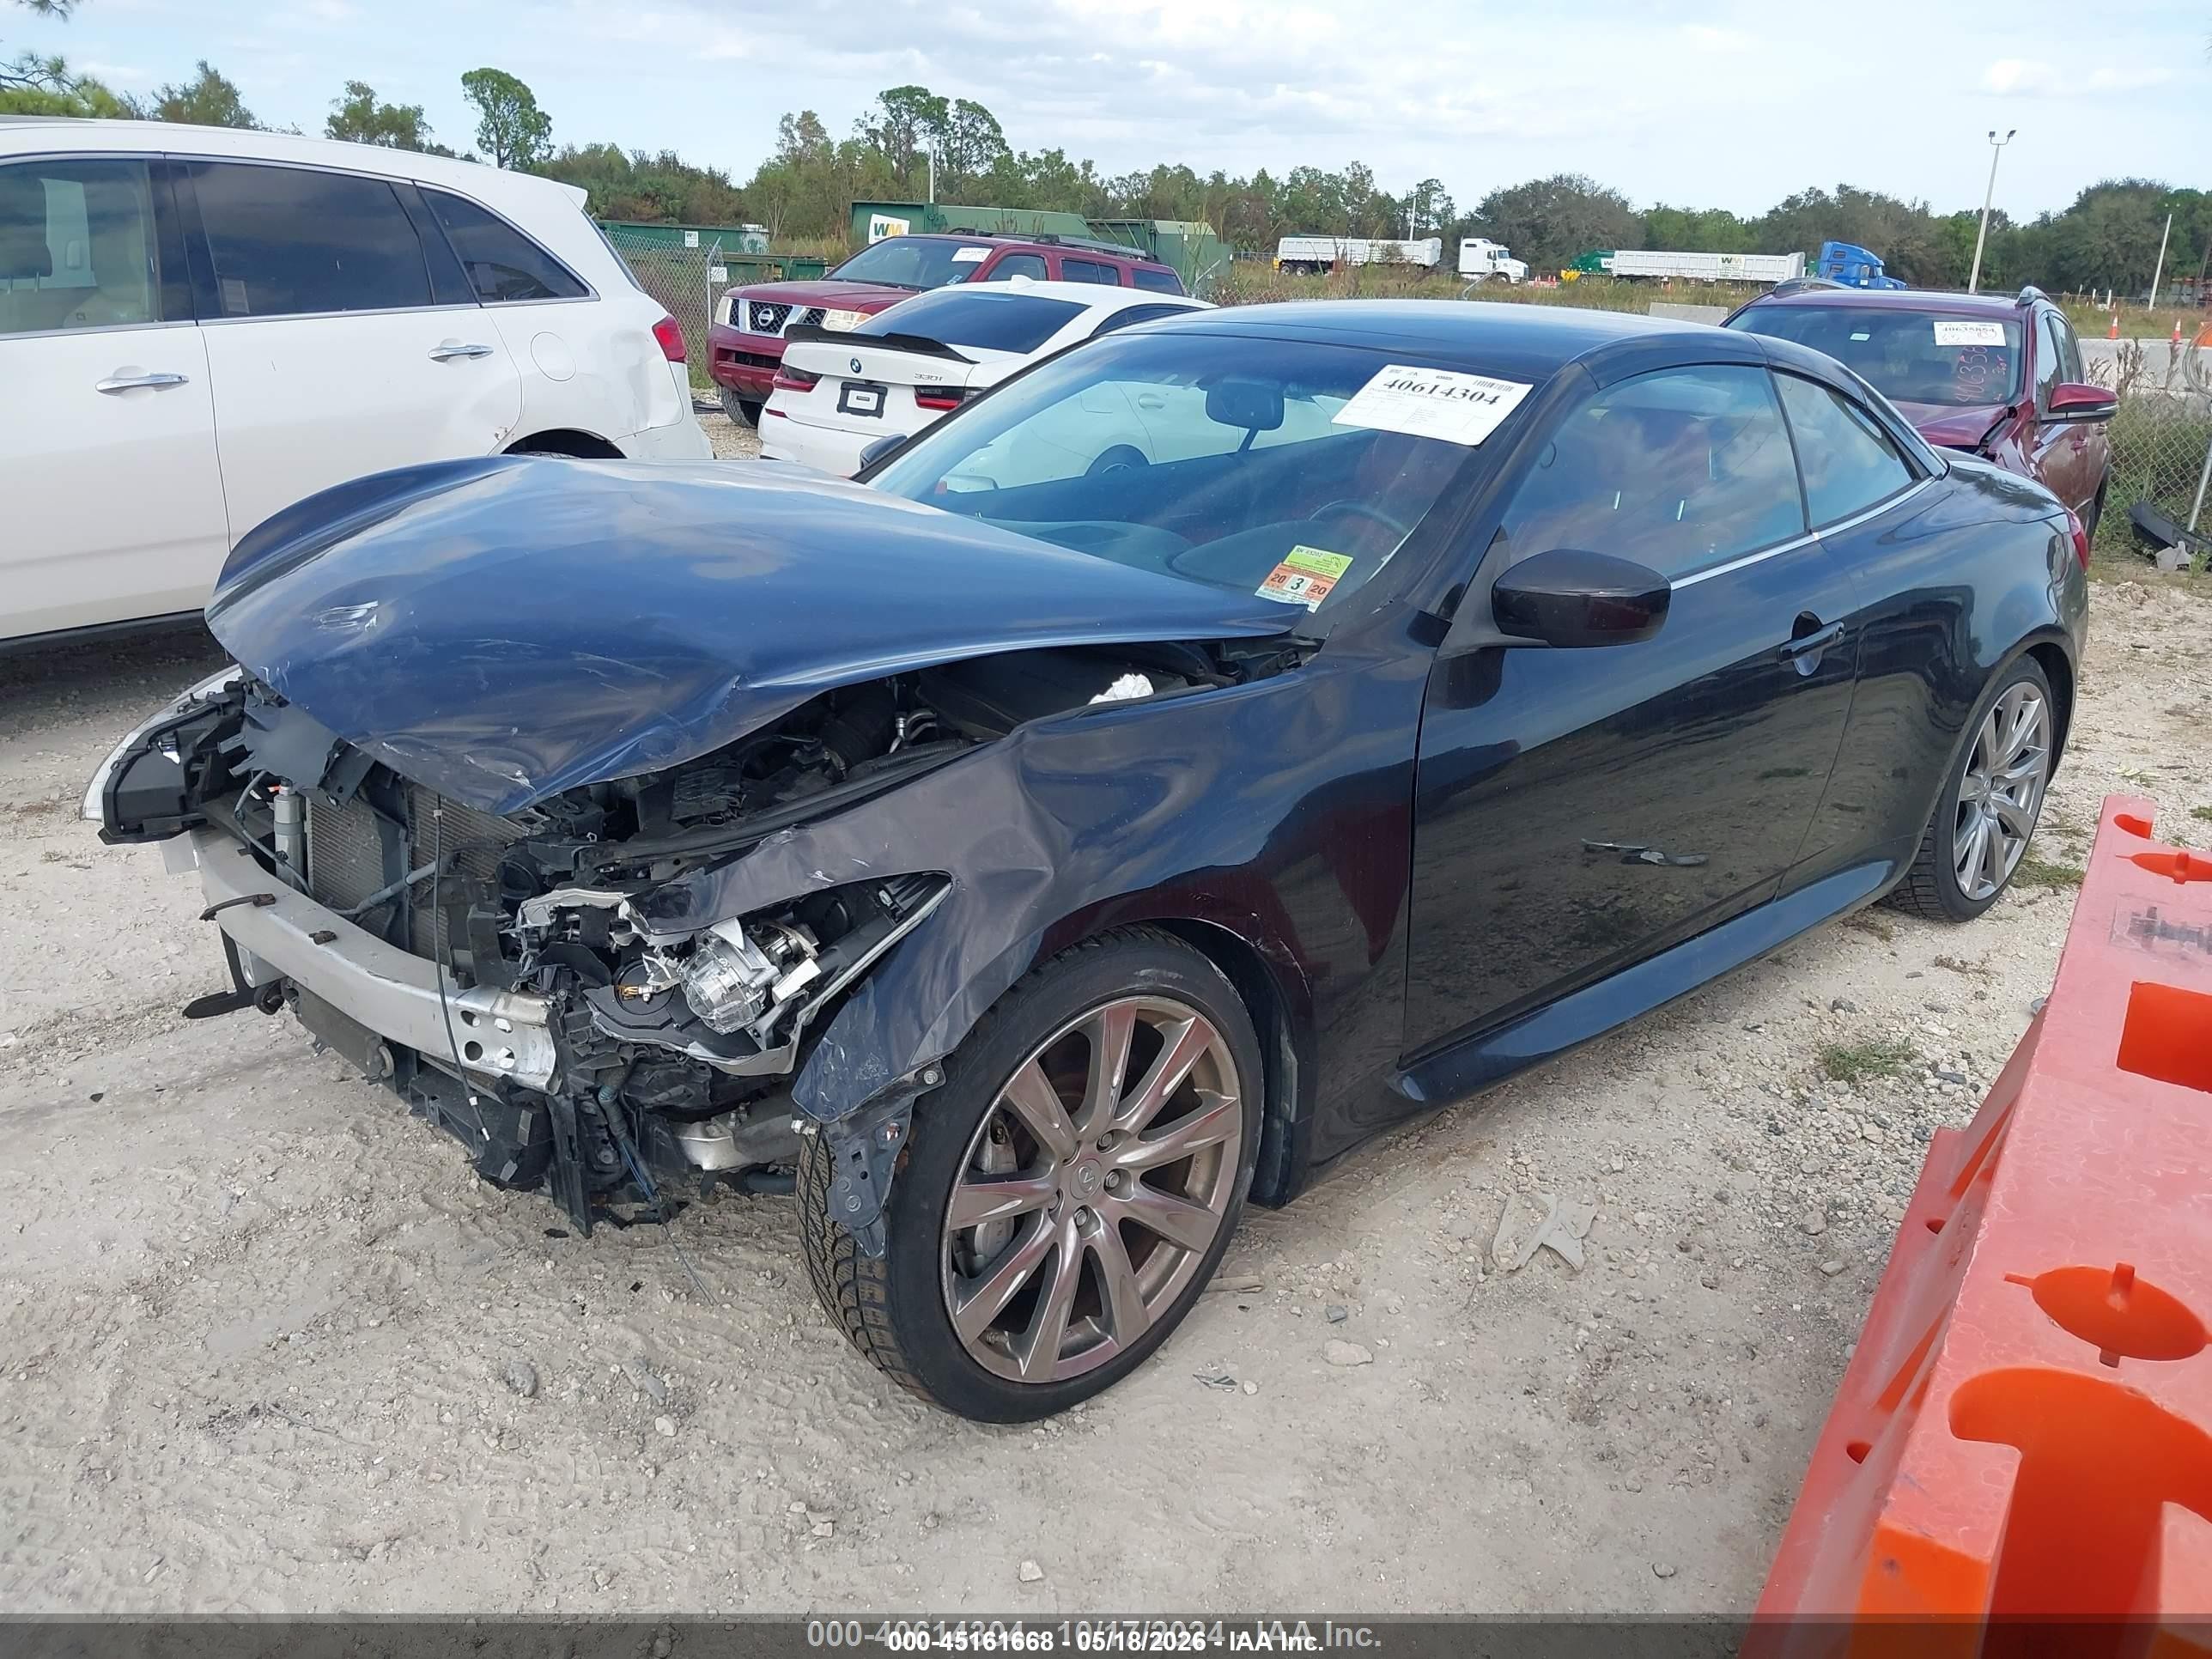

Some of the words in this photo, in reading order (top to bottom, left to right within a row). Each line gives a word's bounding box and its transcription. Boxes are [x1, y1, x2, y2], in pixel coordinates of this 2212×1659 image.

[874, 223, 904, 236] WM
[1383, 379, 1500, 405] 40614304
[1271, 573, 1286, 584] 20
[1291, 578, 1304, 590] 3
[1310, 585, 1327, 595] 20
